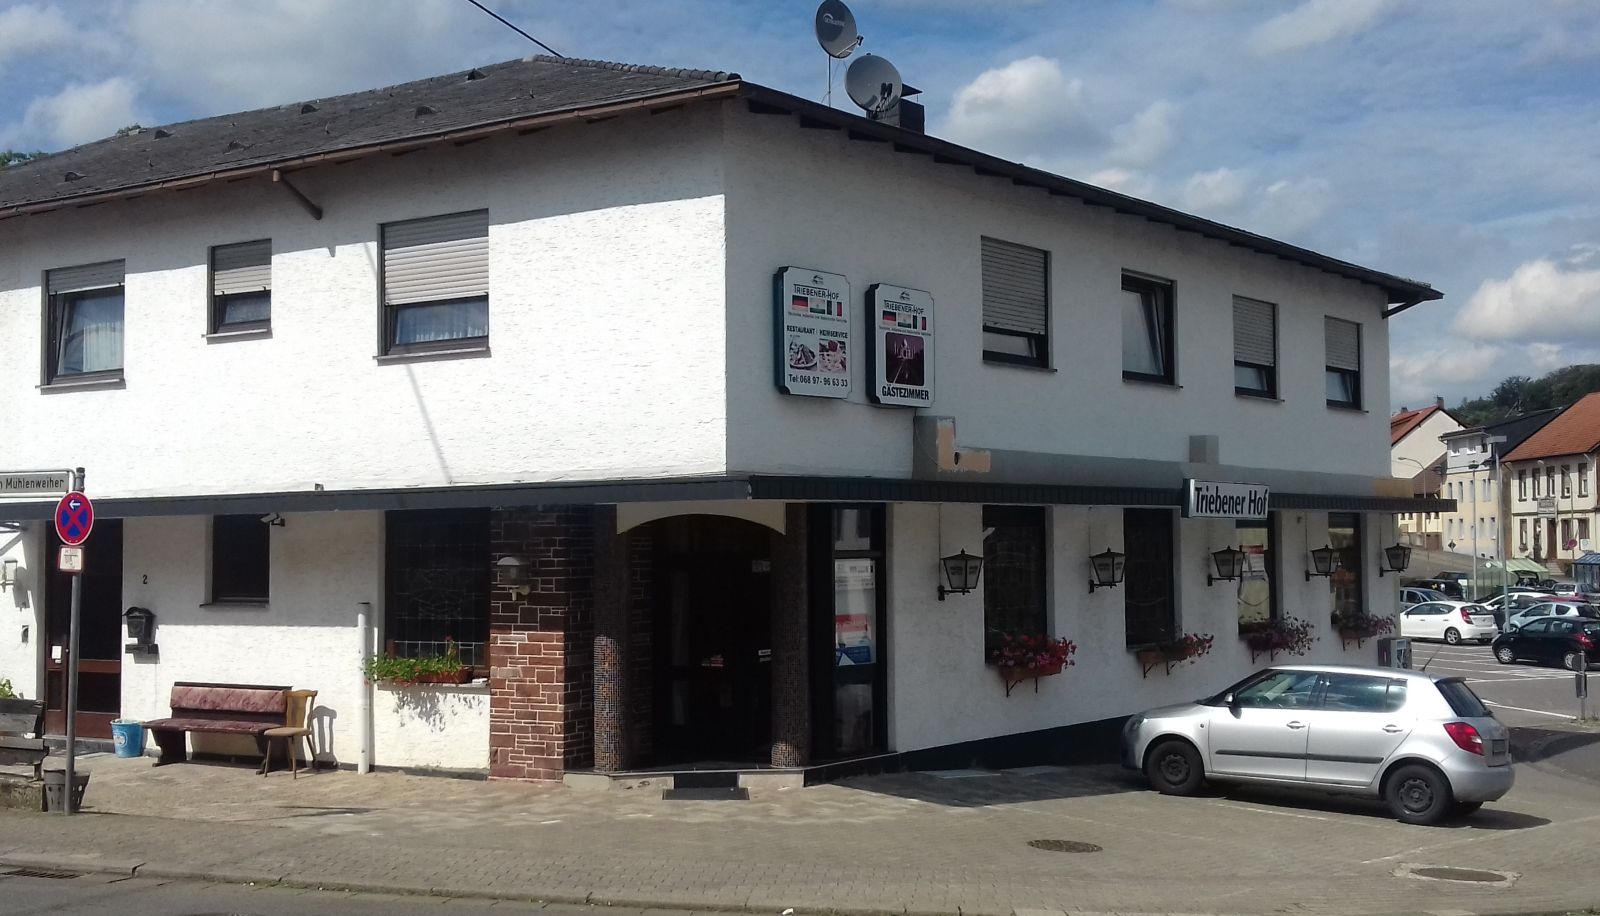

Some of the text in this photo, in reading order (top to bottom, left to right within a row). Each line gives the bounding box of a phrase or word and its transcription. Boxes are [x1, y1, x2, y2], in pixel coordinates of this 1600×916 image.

[793, 284, 839, 300] TRIEBENER-HOF
[884, 300, 925, 314] TRIEBENER-HOF
[787, 325, 815, 335] RESTAURANT
[882, 384, 929, 400] GÄSTEZIMMER
[6, 477, 64, 489] Mühlenweiher
[1195, 486, 1268, 515] Triebener Hof
[142, 574, 148, 584] 2
